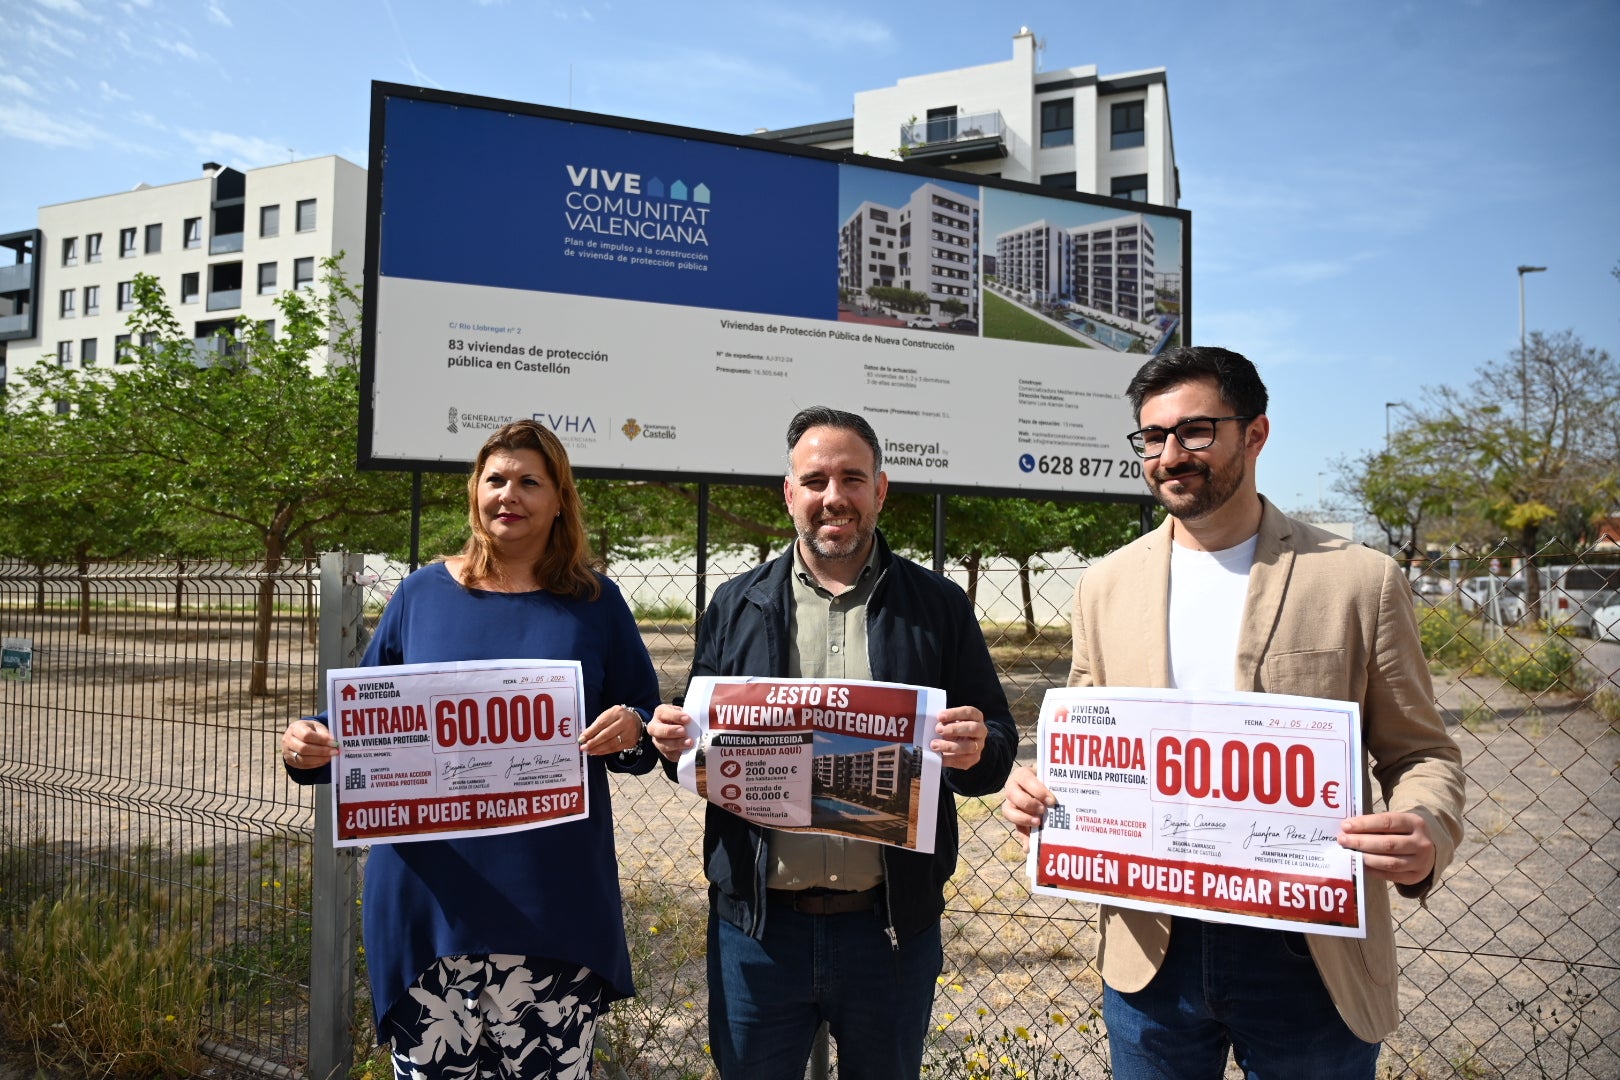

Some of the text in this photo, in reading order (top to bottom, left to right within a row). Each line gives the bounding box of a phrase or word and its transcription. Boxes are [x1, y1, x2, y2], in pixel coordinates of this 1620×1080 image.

[566, 165, 641, 194] VIVE
[566, 192, 710, 225] COMUNITAT
[565, 211, 708, 246] VALENCIANA
[565, 237, 583, 246] Plan
[588, 240, 597, 248] de
[601, 241, 634, 253] impulso
[656, 249, 708, 261] construcción
[579, 251, 613, 261] vivienda
[617, 255, 627, 263] de
[631, 257, 675, 268] protección
[678, 261, 707, 271] pública
[473, 324, 505, 333] Llobregat
[720, 320, 954, 351] Viviendas de Protección Pública de Nueva Construcción
[448, 339, 608, 362] 83 viviendas de protección
[448, 356, 570, 374] pública en Castellón
[461, 414, 513, 422] GENERALITAT
[461, 422, 502, 430] VALENCIA
[643, 430, 676, 439] Castelló
[885, 438, 939, 456] inseryal
[885, 456, 949, 468] MARINA D'OR
[1038, 455, 1141, 479] 628 877 20
[359, 683, 394, 691] VIVIENDA
[359, 690, 401, 700] PROTEGIDA
[766, 686, 850, 709] ¿ESTO ES
[1071, 704, 1110, 715] VIVIENDA
[341, 704, 428, 737] ENTRADA
[435, 693, 572, 747] 60.000 €
[715, 705, 909, 737] VIVIENDA PROTEGIDA?
[1071, 714, 1117, 726] PROTEGIDA
[1311, 721, 1333, 729] 2025
[343, 734, 431, 748] PARA VIVIENDA PROTEGIDA:
[720, 735, 803, 745] VIVIENDA PROTEGIDA
[720, 745, 802, 757] (LA REALIDAD AQUÍ)
[1050, 732, 1146, 771] ENTRADA
[745, 766, 798, 776] 200 000 €
[1050, 768, 1148, 784] PARA VIVIENDA PROTEGIDA:
[1156, 735, 1340, 809] 60.000 €
[745, 792, 781, 800] 60.000
[345, 791, 579, 830] ¿QUIÉN PUEDE PAGAR ESTO?
[1076, 815, 1146, 828] ENTRADA PARA ACCEDER
[1193, 813, 1227, 828] Carrasco
[1081, 825, 1107, 834] VIVIENDA
[1109, 828, 1142, 838] PROTEGIDA
[1243, 821, 1338, 849] Juanfran Pérez Llorca
[1261, 850, 1288, 858] JUANFRAN
[1045, 852, 1348, 914] ¿QUIÉN PUEDE PAGAR ESTO?
